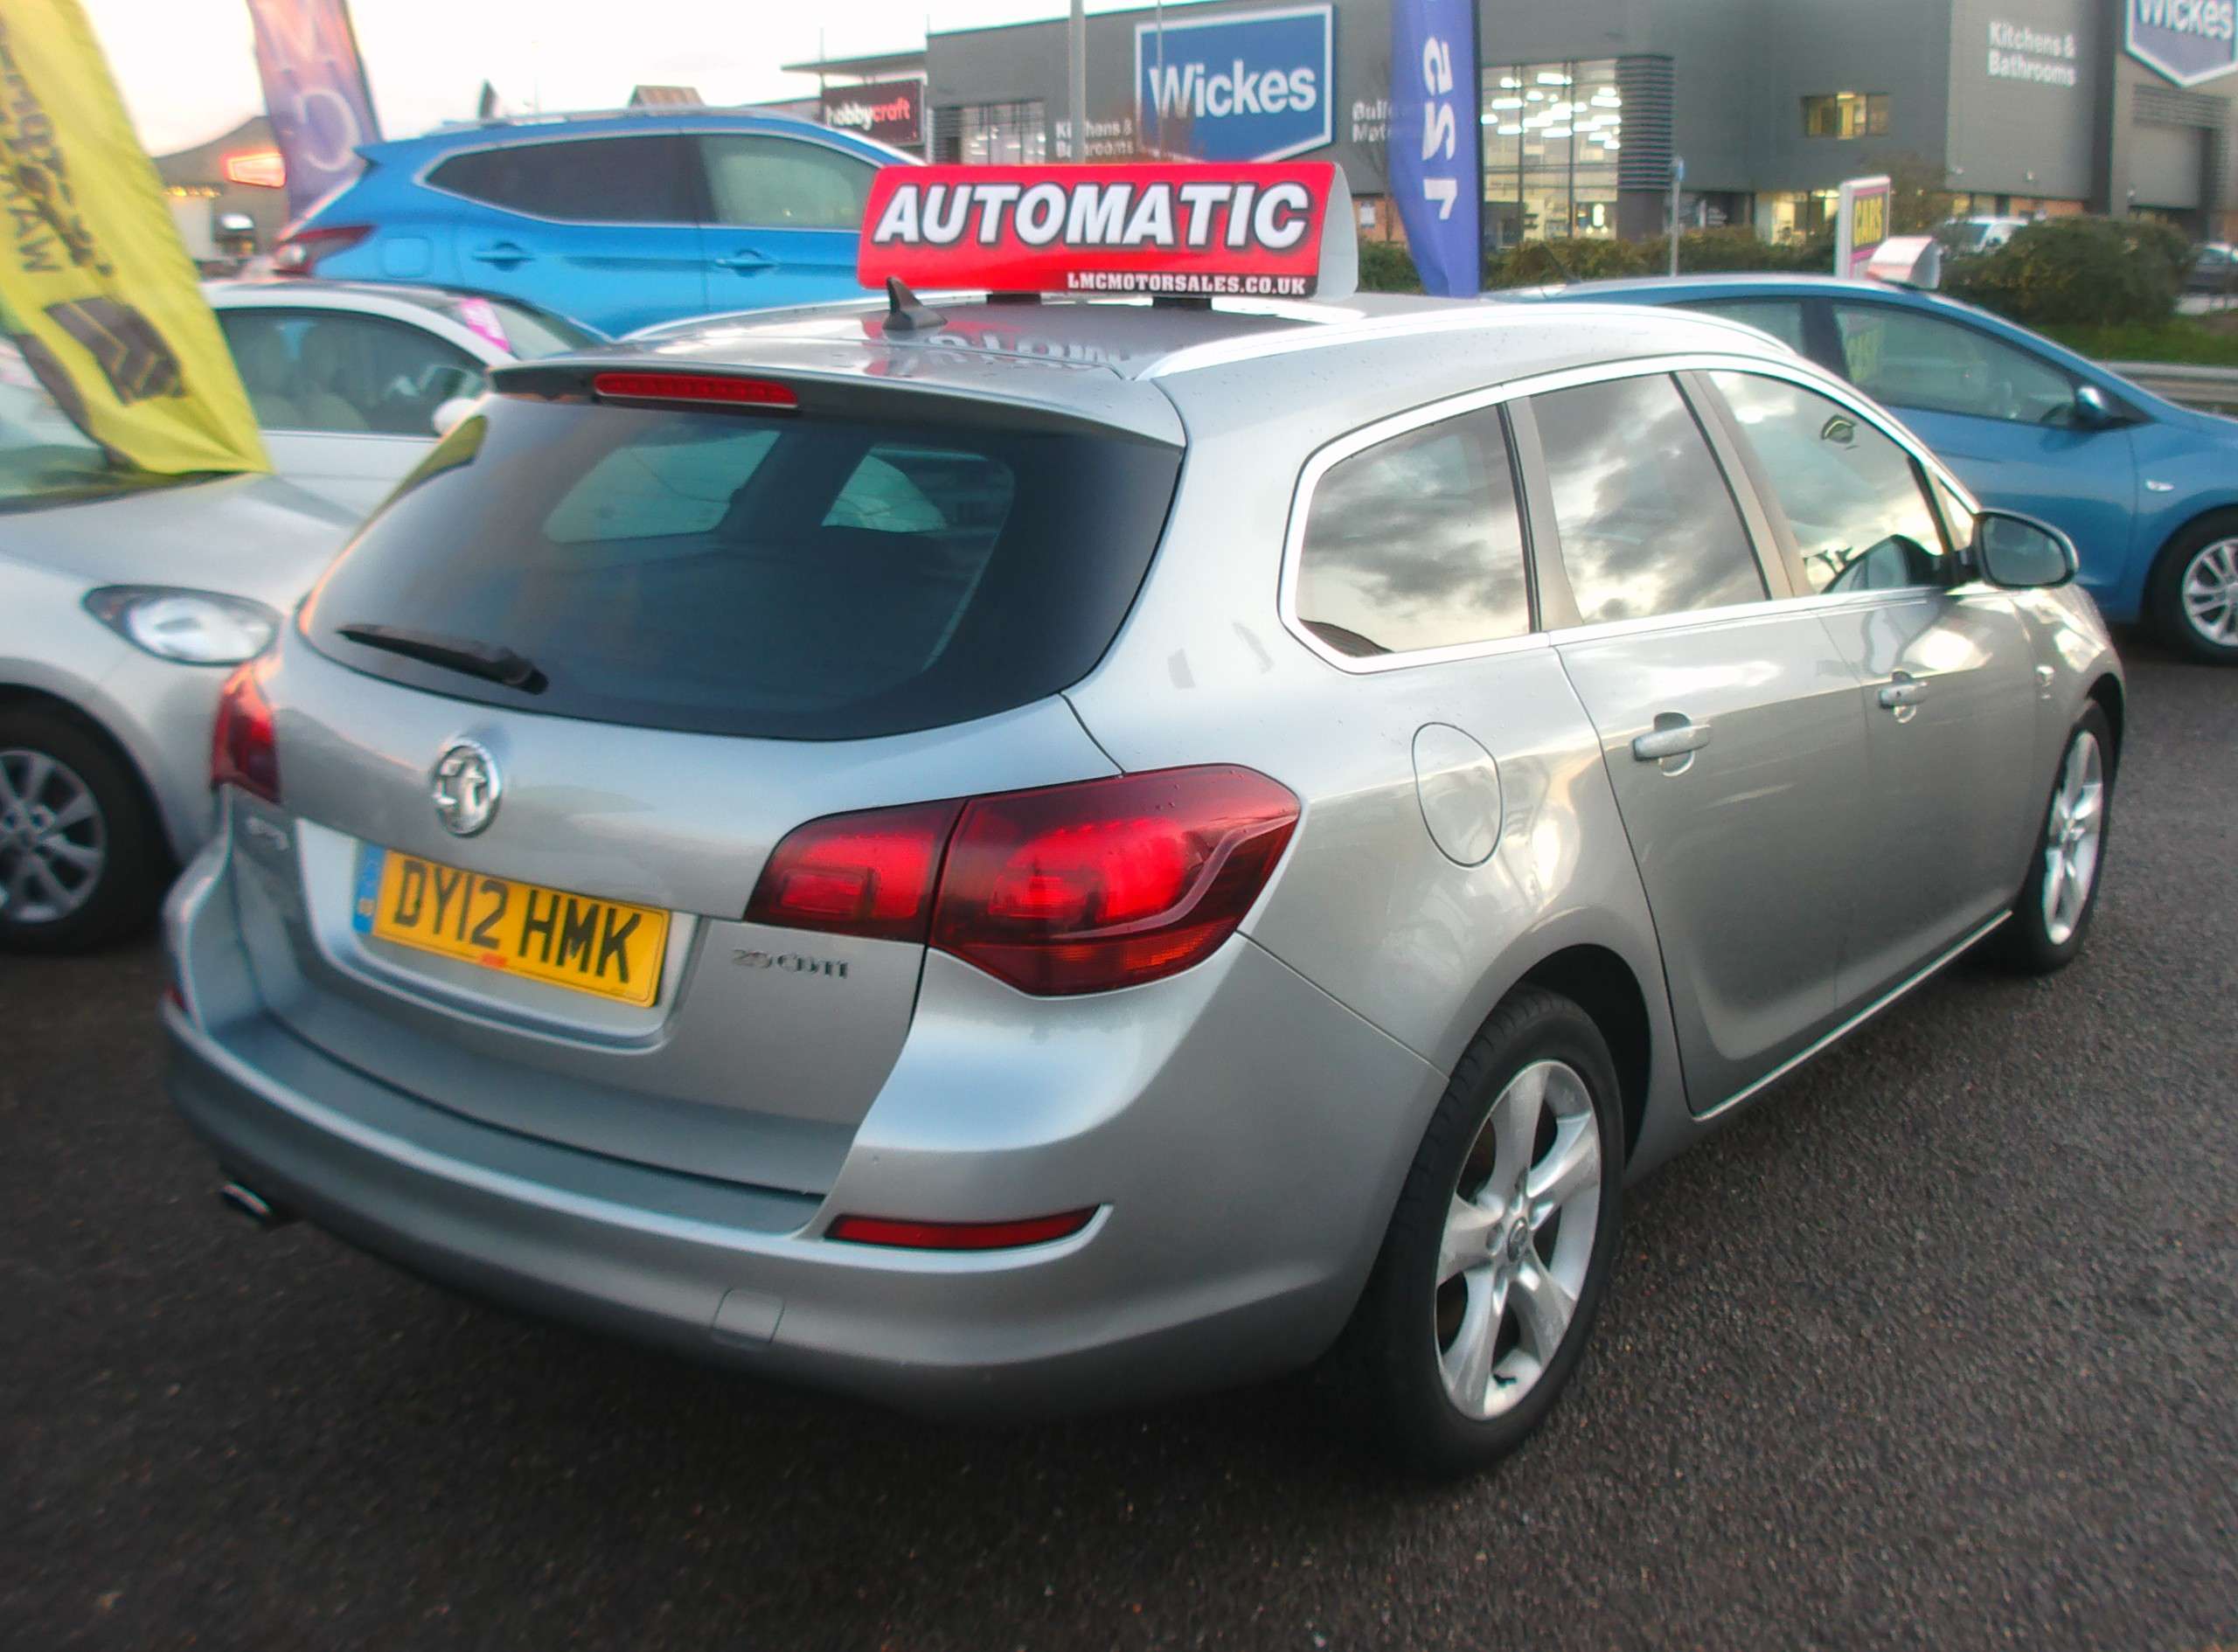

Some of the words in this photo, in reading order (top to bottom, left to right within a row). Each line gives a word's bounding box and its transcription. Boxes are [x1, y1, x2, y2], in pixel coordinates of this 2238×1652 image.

[1149, 58, 1317, 119] Wickes
[873, 182, 1310, 249] AUTOMATIC
[1067, 272, 1306, 295] LMCMOTORSALES.CO.UK
[393, 859, 510, 950] DY12
[518, 889, 643, 984] HMK
